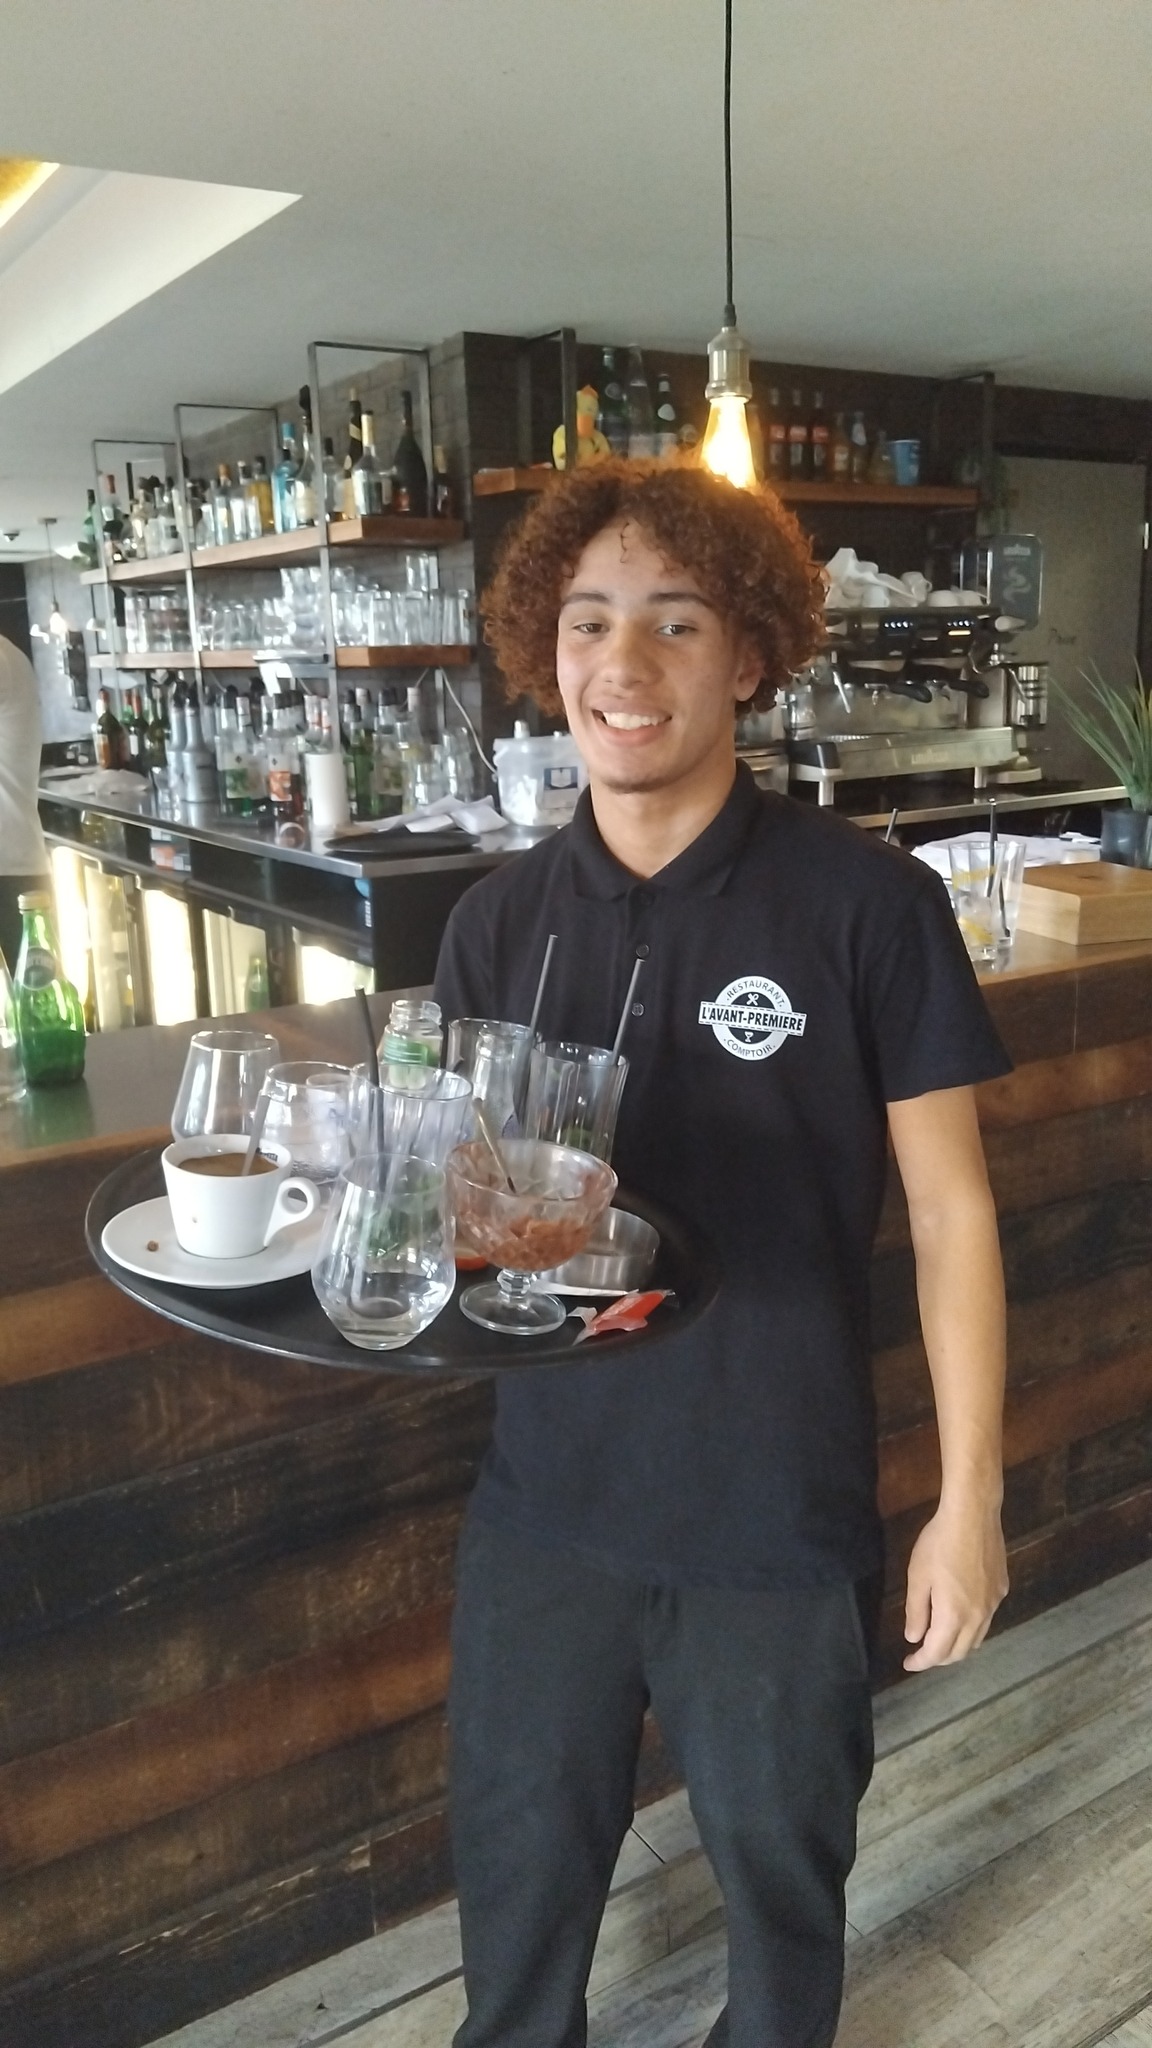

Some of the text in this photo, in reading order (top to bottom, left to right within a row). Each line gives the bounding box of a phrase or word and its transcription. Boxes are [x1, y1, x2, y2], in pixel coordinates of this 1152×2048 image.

[726, 980, 785, 1004] RESTAURANT
[702, 1006, 803, 1031] L'AVANT-PREMIERE
[727, 1039, 773, 1058] COMPTOIR
